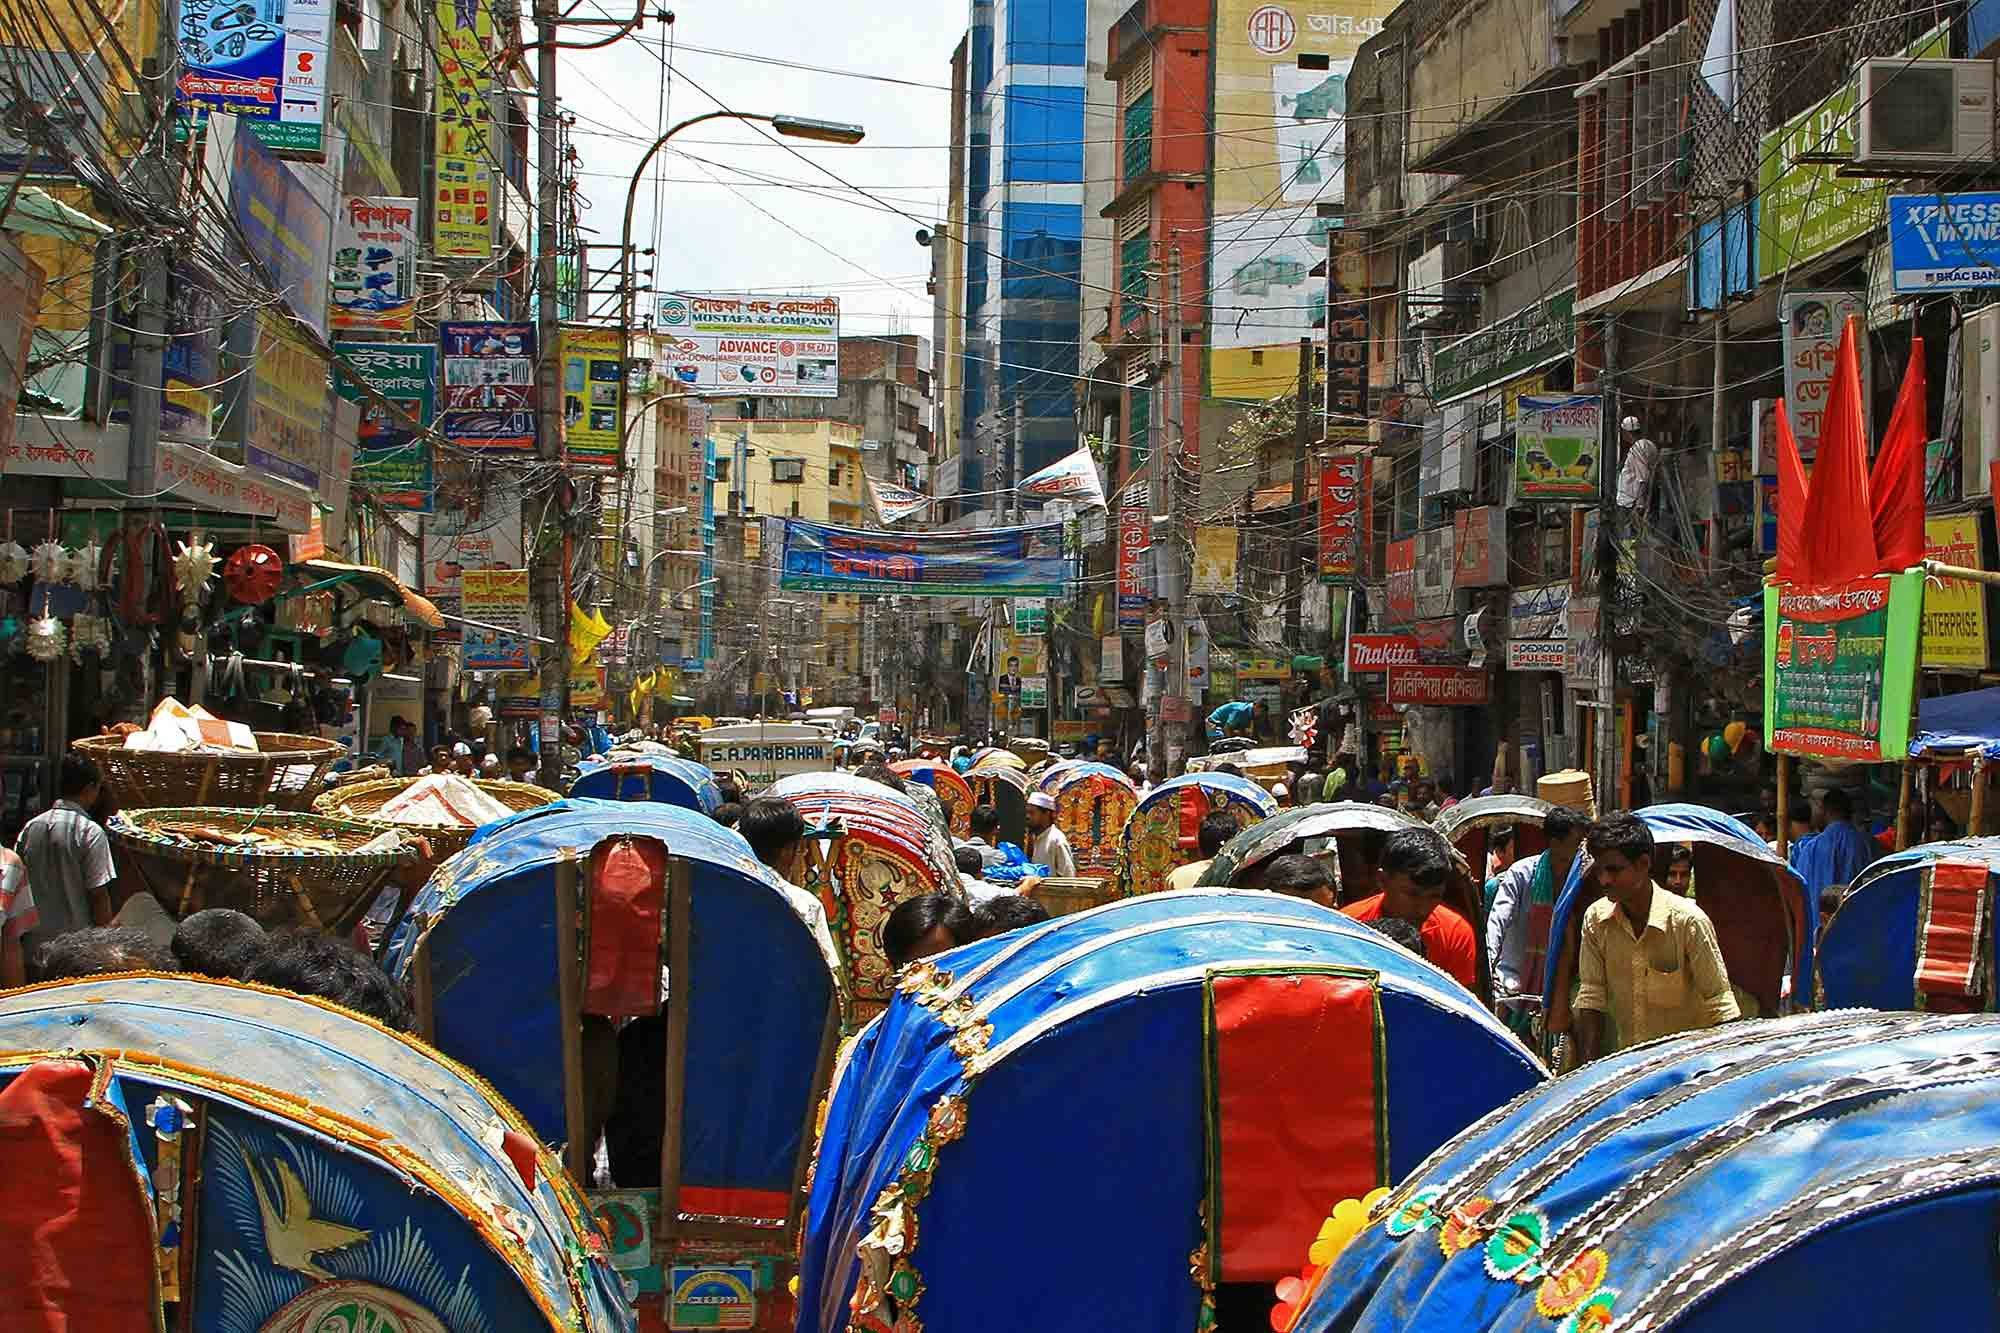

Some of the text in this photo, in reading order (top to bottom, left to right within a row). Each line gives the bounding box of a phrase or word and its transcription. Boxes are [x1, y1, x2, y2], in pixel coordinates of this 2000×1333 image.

[288, 76, 314, 85] NITTA
[1905, 204, 2000, 225] XPRESS
[1936, 271, 2000, 281] BRAC BAN
[692, 314, 753, 324] MOSTAFA
[771, 316, 835, 326] COMPANY
[719, 341, 777, 354] ADVANCE
[763, 355, 777, 363] BOX
[1922, 612, 1978, 637] ENTERPRISE
[1353, 642, 1416, 665] Makita
[1520, 654, 1564, 663] PULSER
